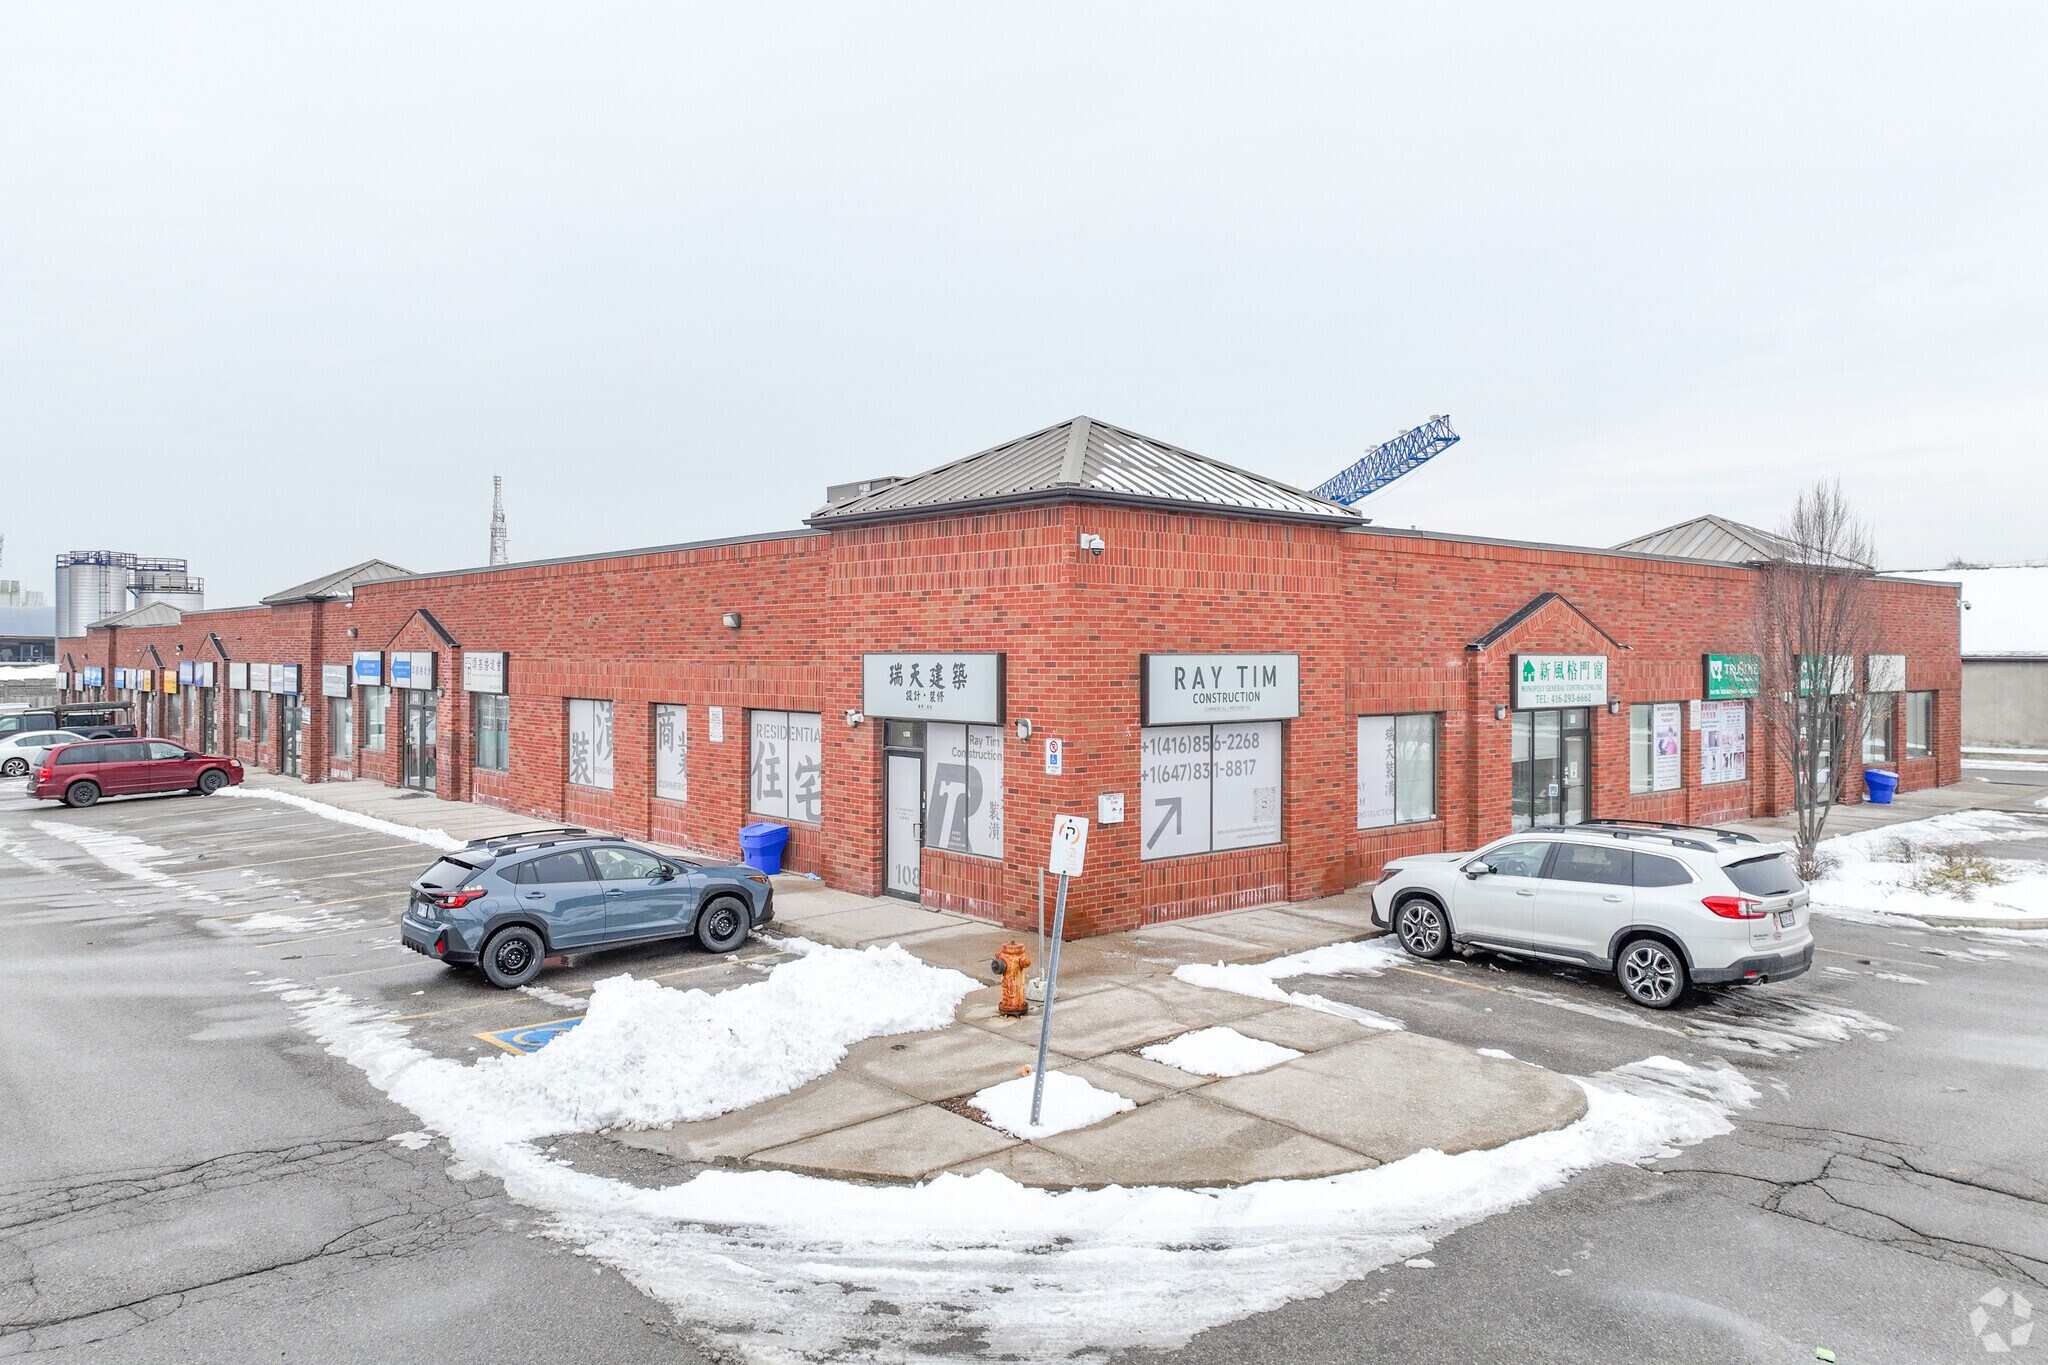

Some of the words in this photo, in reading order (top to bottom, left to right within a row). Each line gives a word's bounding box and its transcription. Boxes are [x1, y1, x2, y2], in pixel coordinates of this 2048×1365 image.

[889, 662, 968, 690] 瑞天建築
[1174, 666, 1223, 690] RAY
[1236, 665, 1277, 688] TIM
[1540, 660, 1604, 682] 新風格門窗
[1193, 691, 1261, 704] CONSTRUCTION
[1521, 685, 1544, 693] MONOPOLY
[1545, 684, 1565, 692] GENERAL
[1535, 694, 1550, 704] TEL:
[1551, 693, 1592, 704] 416-293-6662
[969, 734, 983, 748] Ray
[985, 735, 1000, 748] Tim
[1141, 732, 1260, 756] +1(416)856-2268
[952, 747, 1003, 762] Construction
[1141, 759, 1257, 784] +1(647)831-8817
[895, 864, 920, 888] 108
